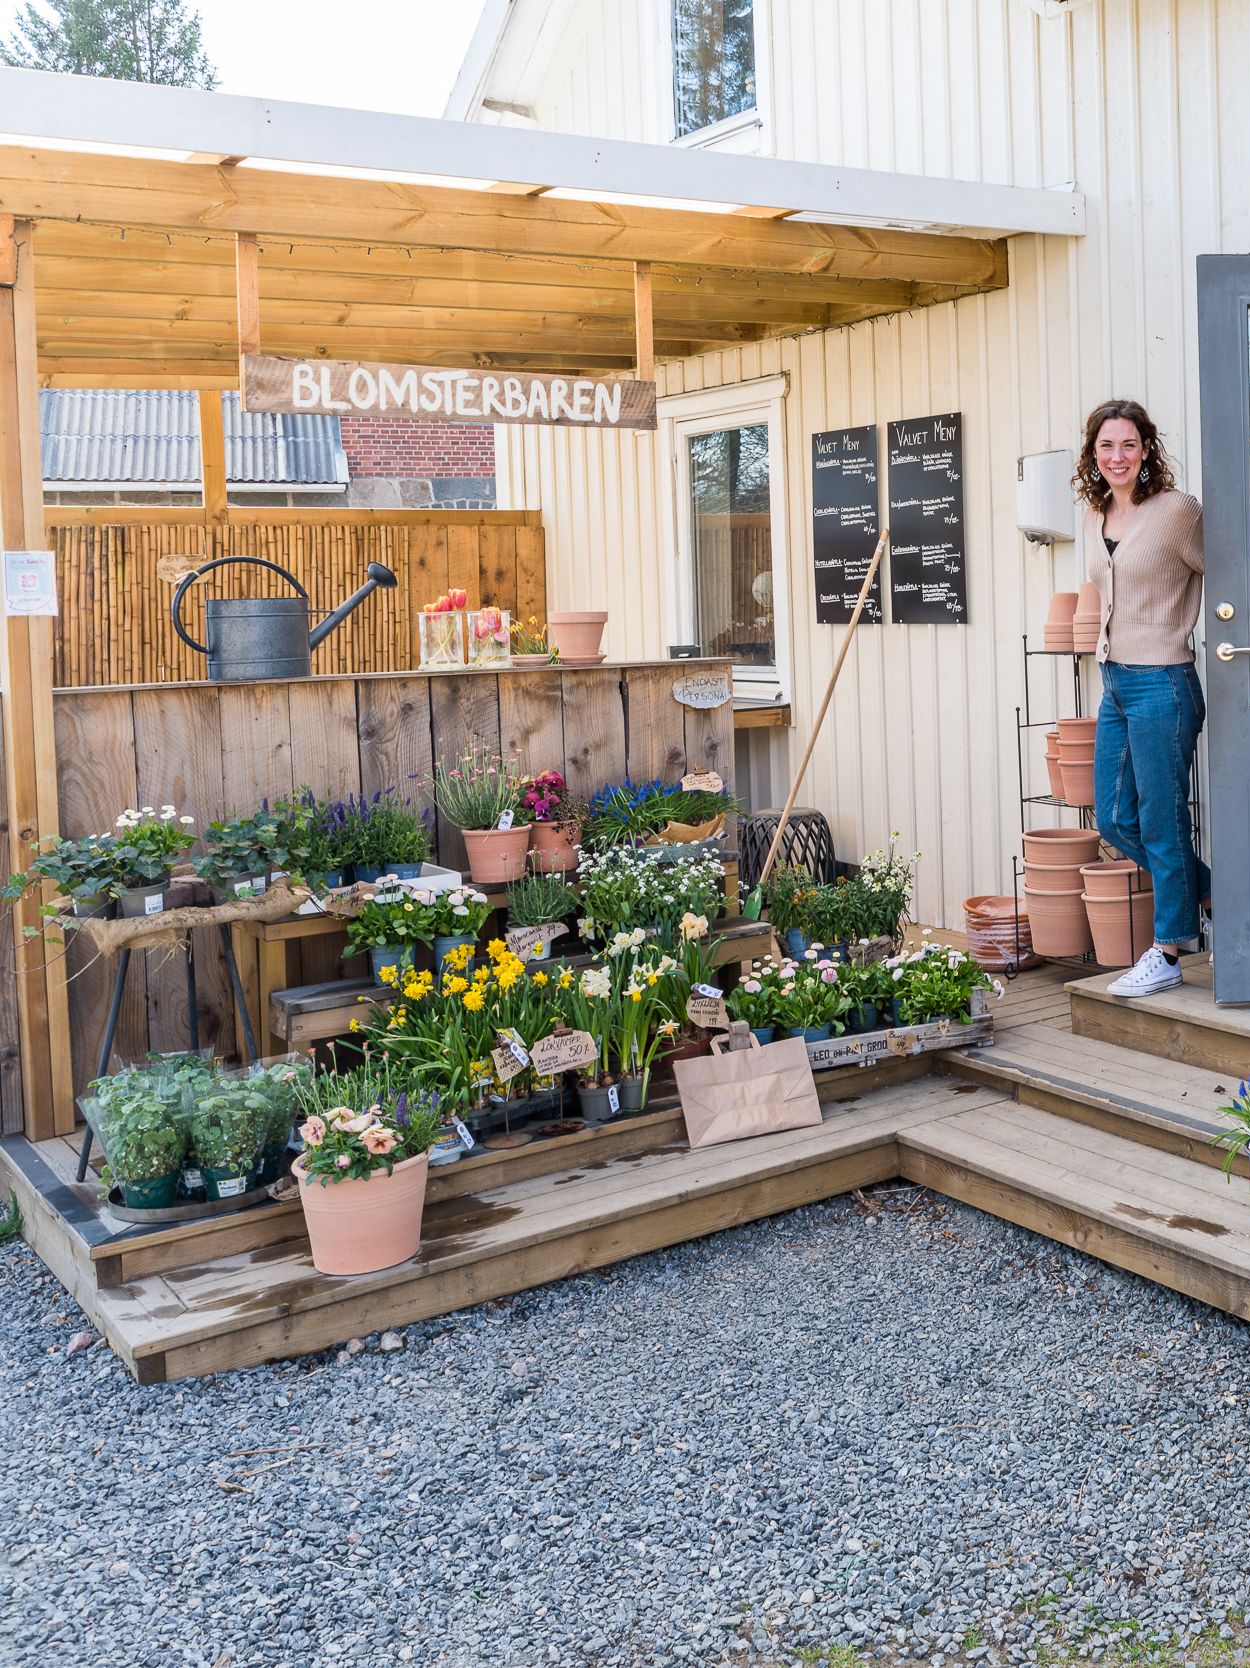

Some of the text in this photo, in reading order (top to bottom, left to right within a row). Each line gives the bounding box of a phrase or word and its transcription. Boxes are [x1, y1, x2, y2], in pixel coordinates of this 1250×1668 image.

[292, 363, 622, 424] BLOMSTERBAREN
[896, 419, 957, 447] VALVET MENY
[685, 677, 725, 688] ENDAST
